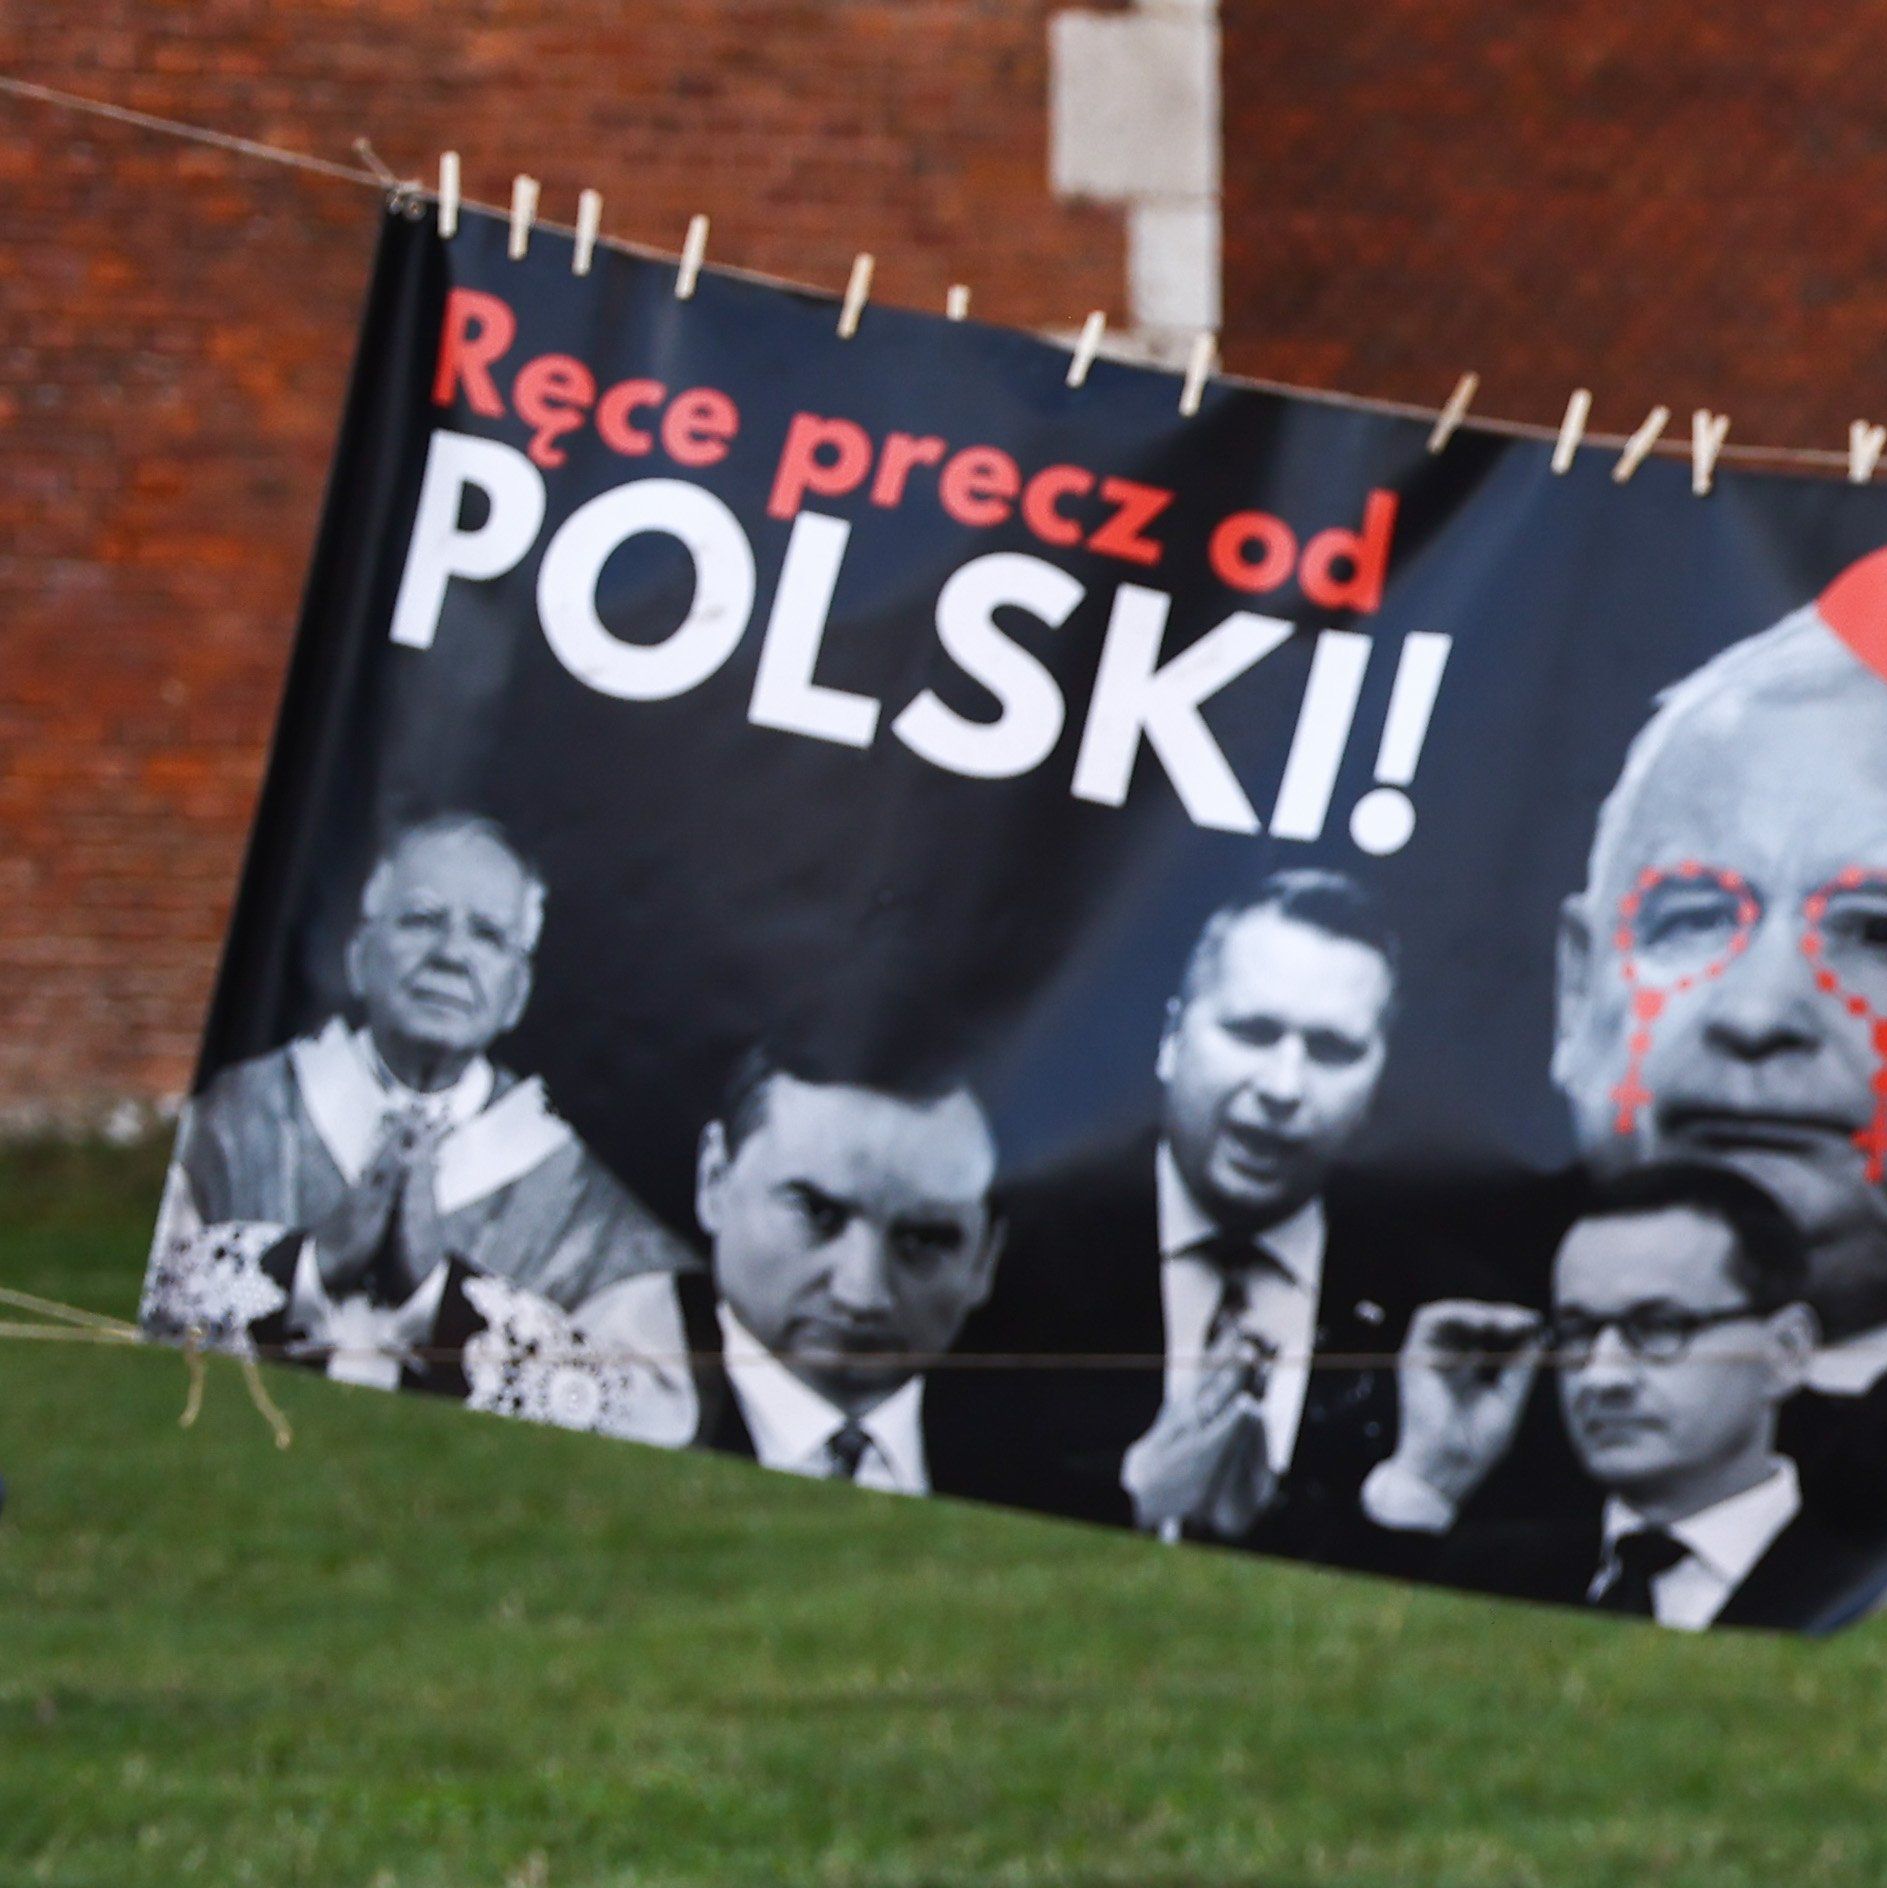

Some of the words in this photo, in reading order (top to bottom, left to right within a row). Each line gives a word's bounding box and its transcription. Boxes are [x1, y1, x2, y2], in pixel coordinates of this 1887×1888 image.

[432, 285, 741, 469] Ręce
[766, 410, 1176, 567] precz
[1206, 487, 1401, 616] od
[389, 429, 1453, 857] POLSKI!
